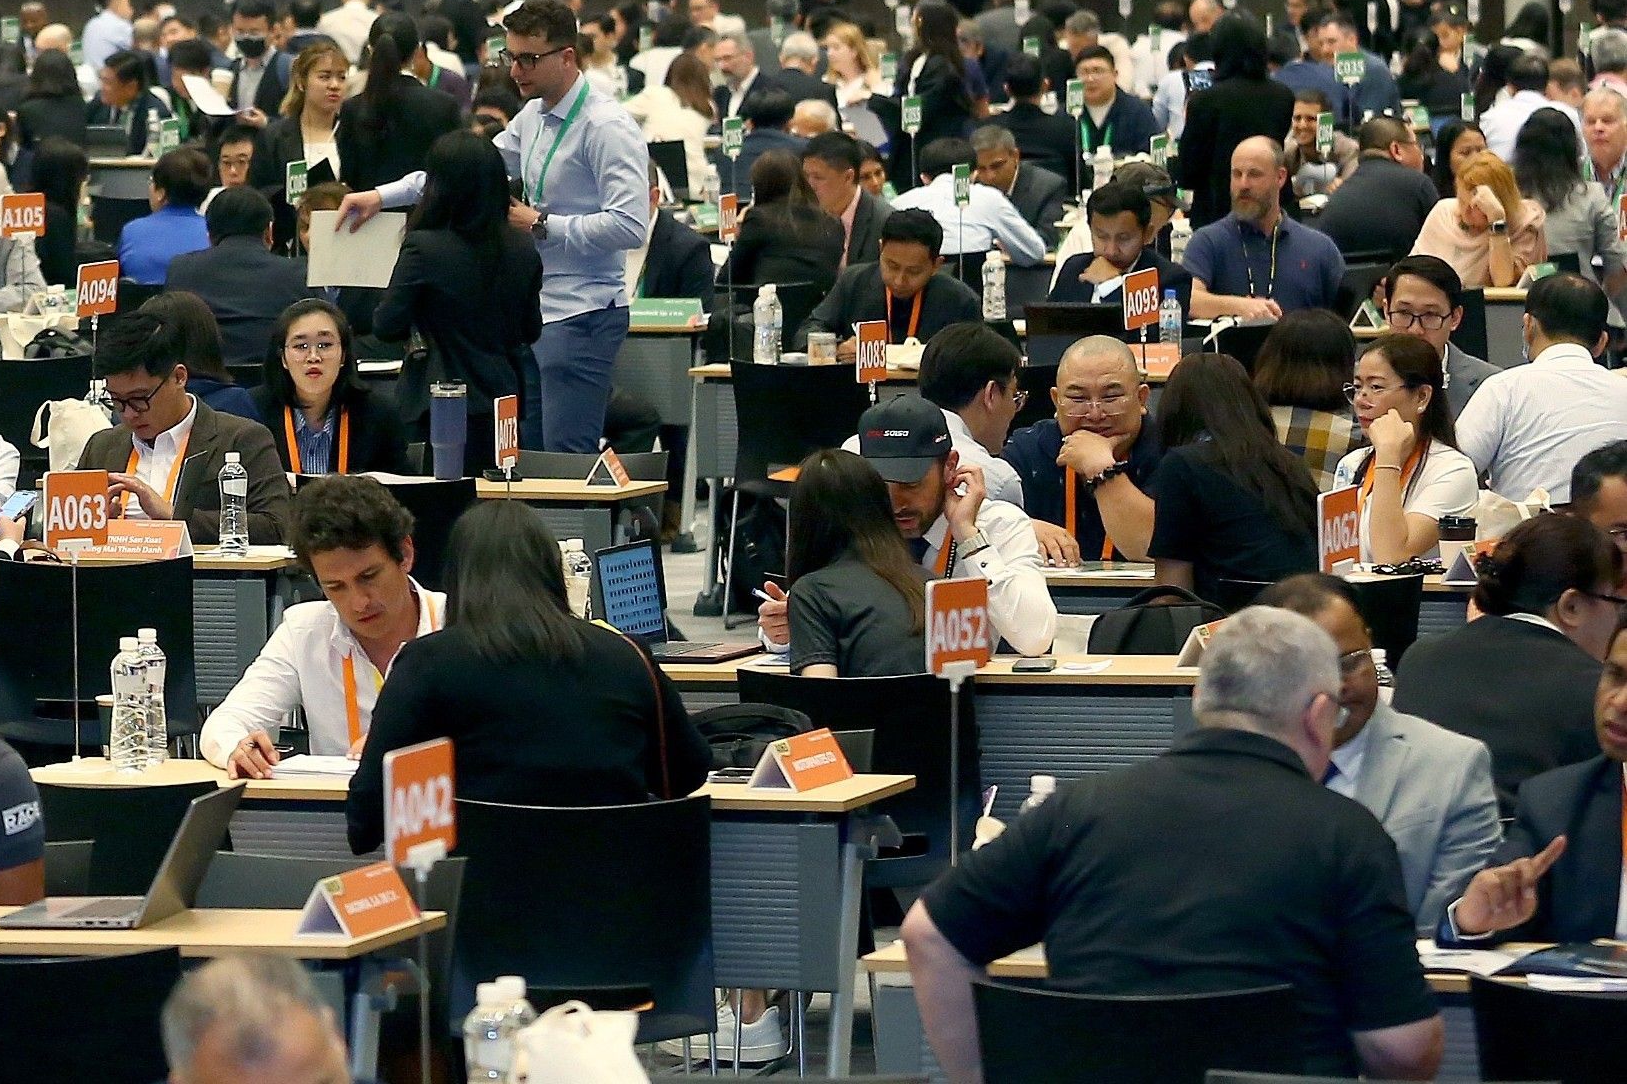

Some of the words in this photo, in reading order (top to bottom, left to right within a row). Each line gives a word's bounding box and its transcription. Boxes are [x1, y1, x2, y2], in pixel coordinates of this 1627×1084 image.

[3, 206, 44, 229] A105
[78, 277, 117, 305] A094
[1127, 285, 1158, 317] A093
[859, 340, 886, 368] A083
[499, 416, 517, 450] A073
[47, 494, 107, 533] A063
[1322, 511, 1359, 552] A062
[931, 606, 988, 652] A052
[392, 777, 453, 836] A042
